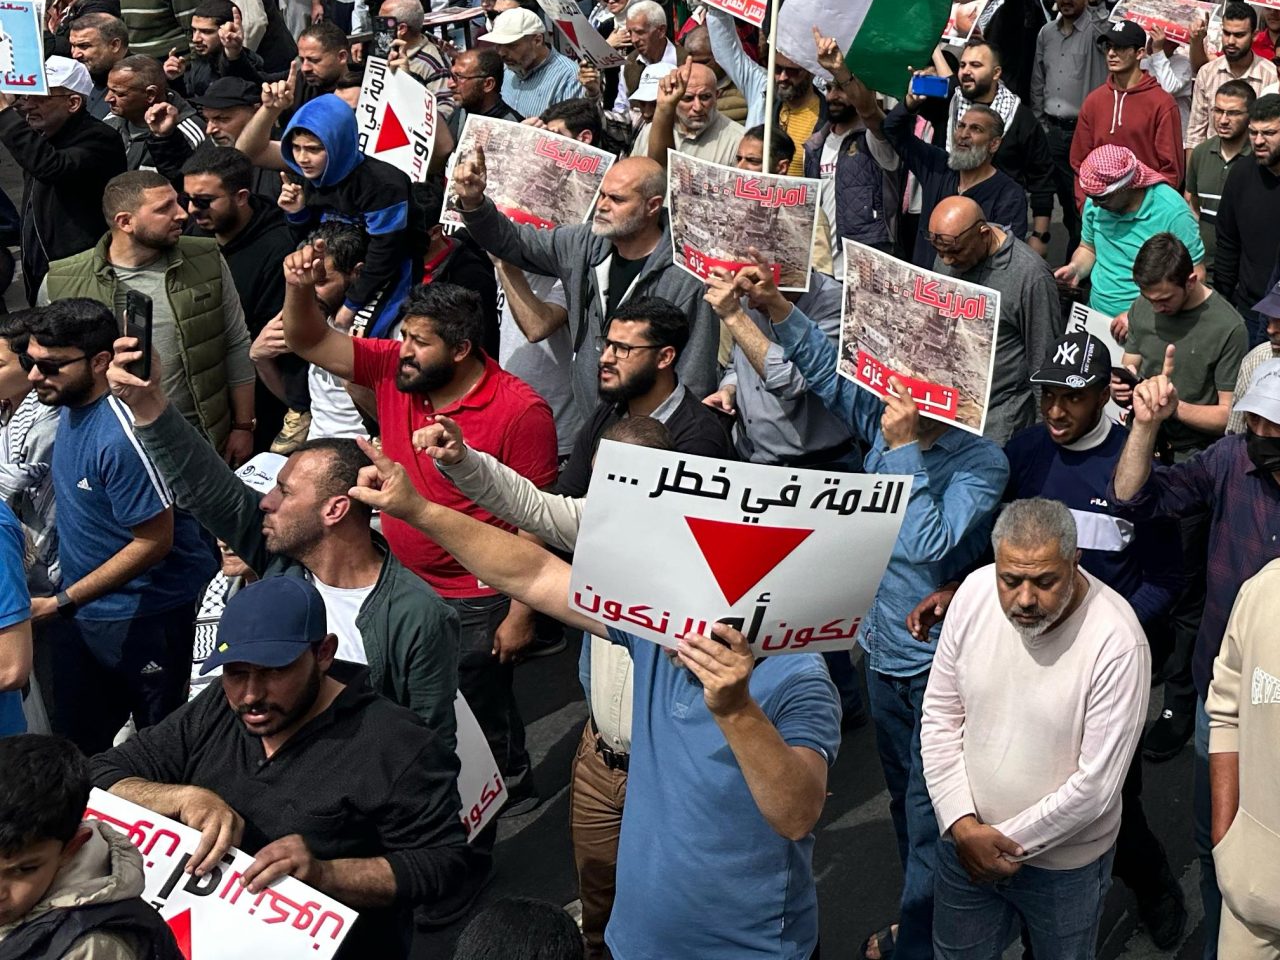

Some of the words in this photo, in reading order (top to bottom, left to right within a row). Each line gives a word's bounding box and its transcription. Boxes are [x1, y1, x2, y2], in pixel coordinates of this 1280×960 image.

[5, 72, 37, 86] كلنا
[364, 58, 387, 101] الأمة
[408, 125, 429, 161] أو
[534, 136, 601, 173] امريكا
[734, 177, 807, 208] امريكا
[688, 249, 706, 273] غزة
[913, 276, 987, 320] امريكا
[1073, 306, 1089, 332] الأم
[862, 358, 887, 388] غزة
[649, 460, 731, 502] خطر
[740, 474, 801, 523] في
[810, 477, 905, 516] الأمة
[1090, 498, 1108, 506] FILA
[573, 585, 670, 635] نكون
[762, 617, 861, 651] نكون
[249, 889, 345, 951] نكون
